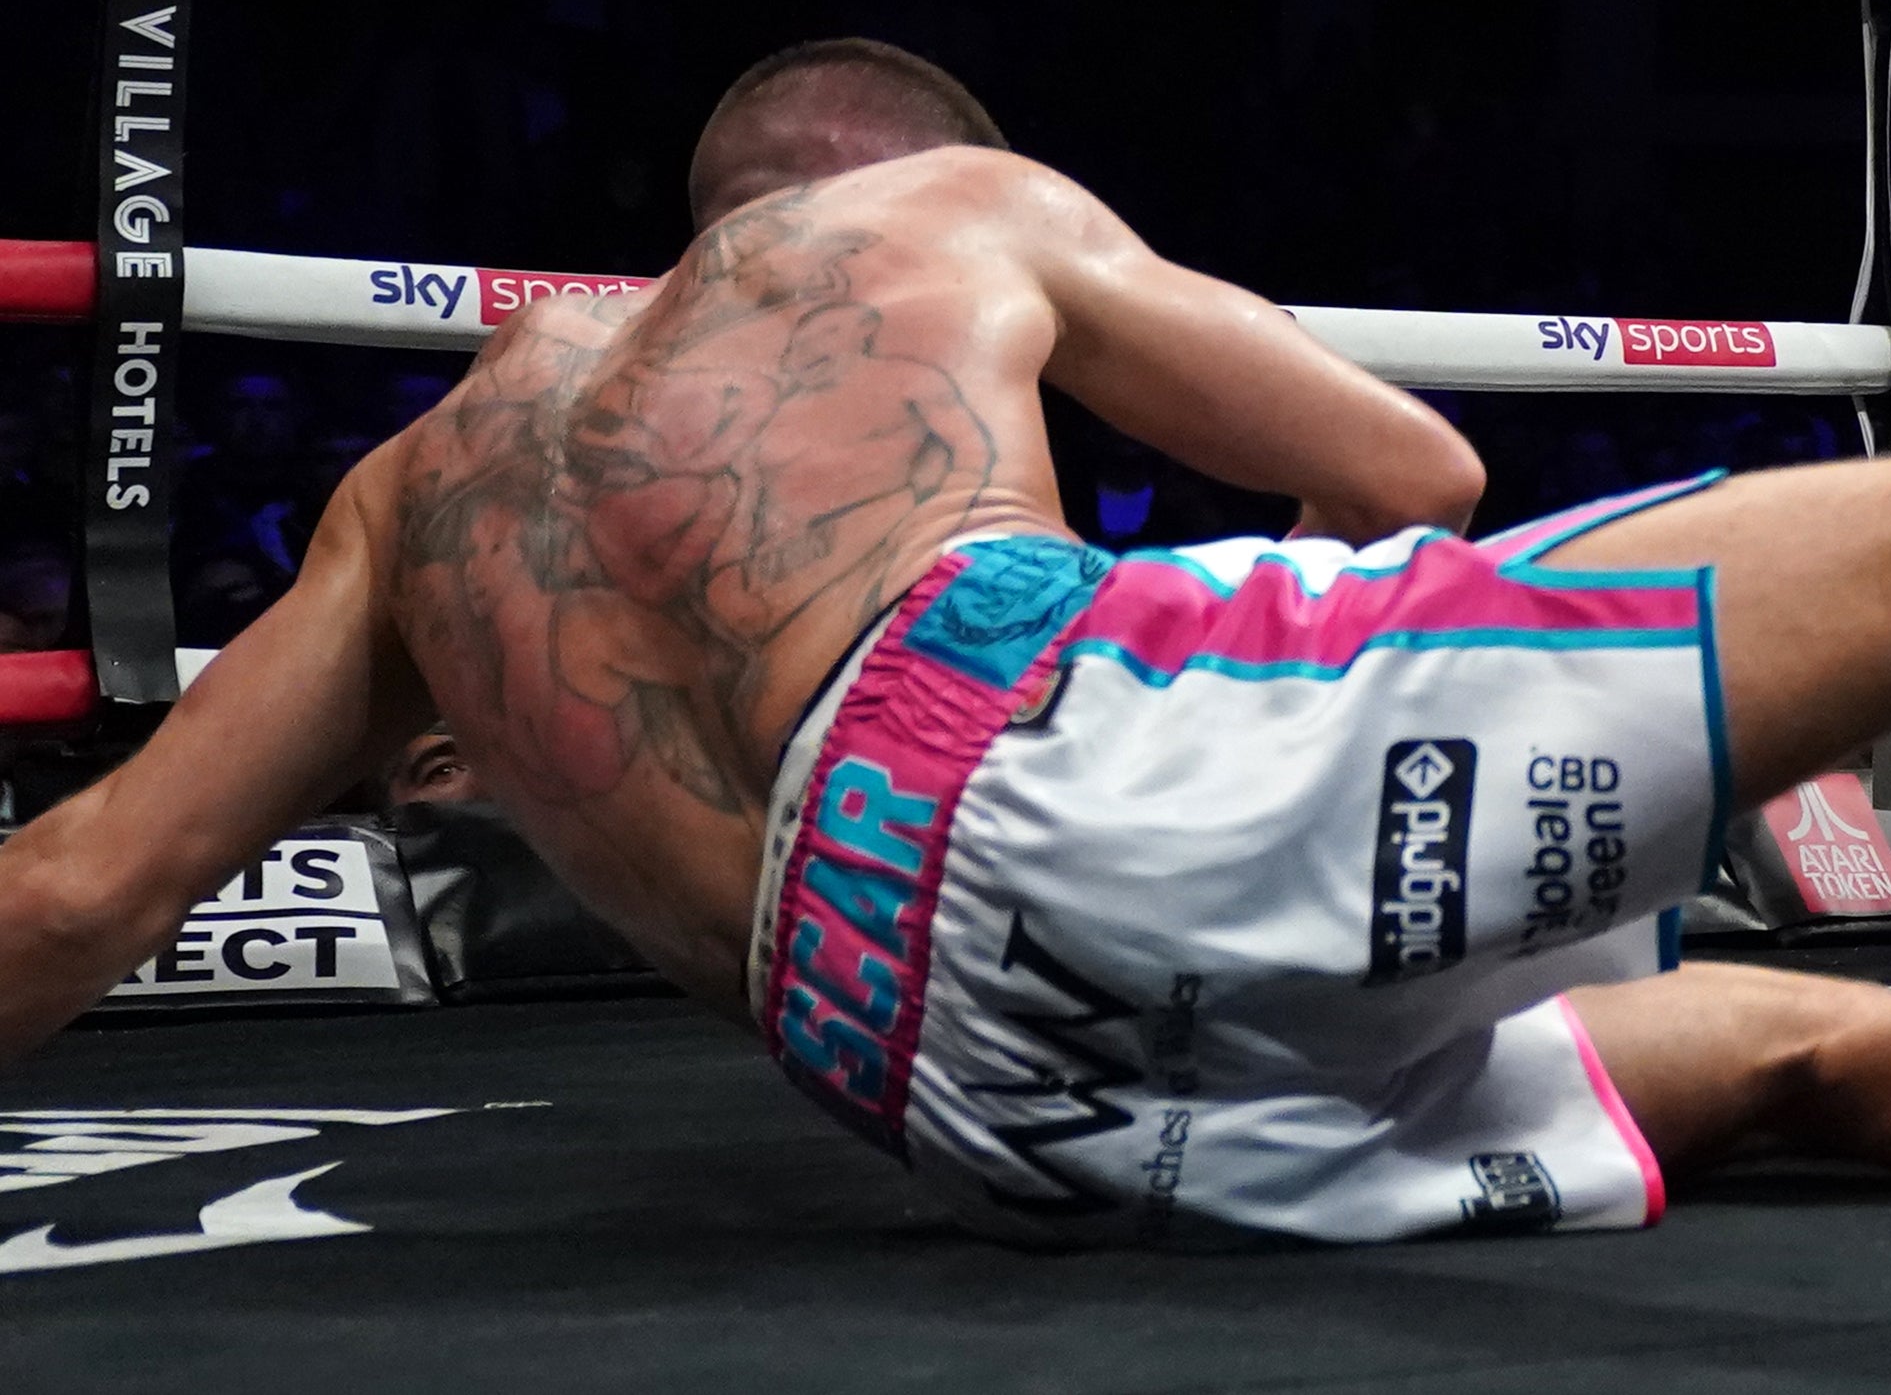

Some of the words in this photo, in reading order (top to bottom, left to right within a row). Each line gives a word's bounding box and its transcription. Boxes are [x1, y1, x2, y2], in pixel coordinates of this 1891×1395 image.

[112, 4, 178, 280] VILLAGE
[369, 264, 468, 319] sky
[1537, 315, 1610, 361] sky
[1631, 320, 1766, 360] sports
[105, 320, 164, 510] HOTELS
[1528, 756, 1619, 792] CBD
[1799, 843, 1885, 873] ATARI
